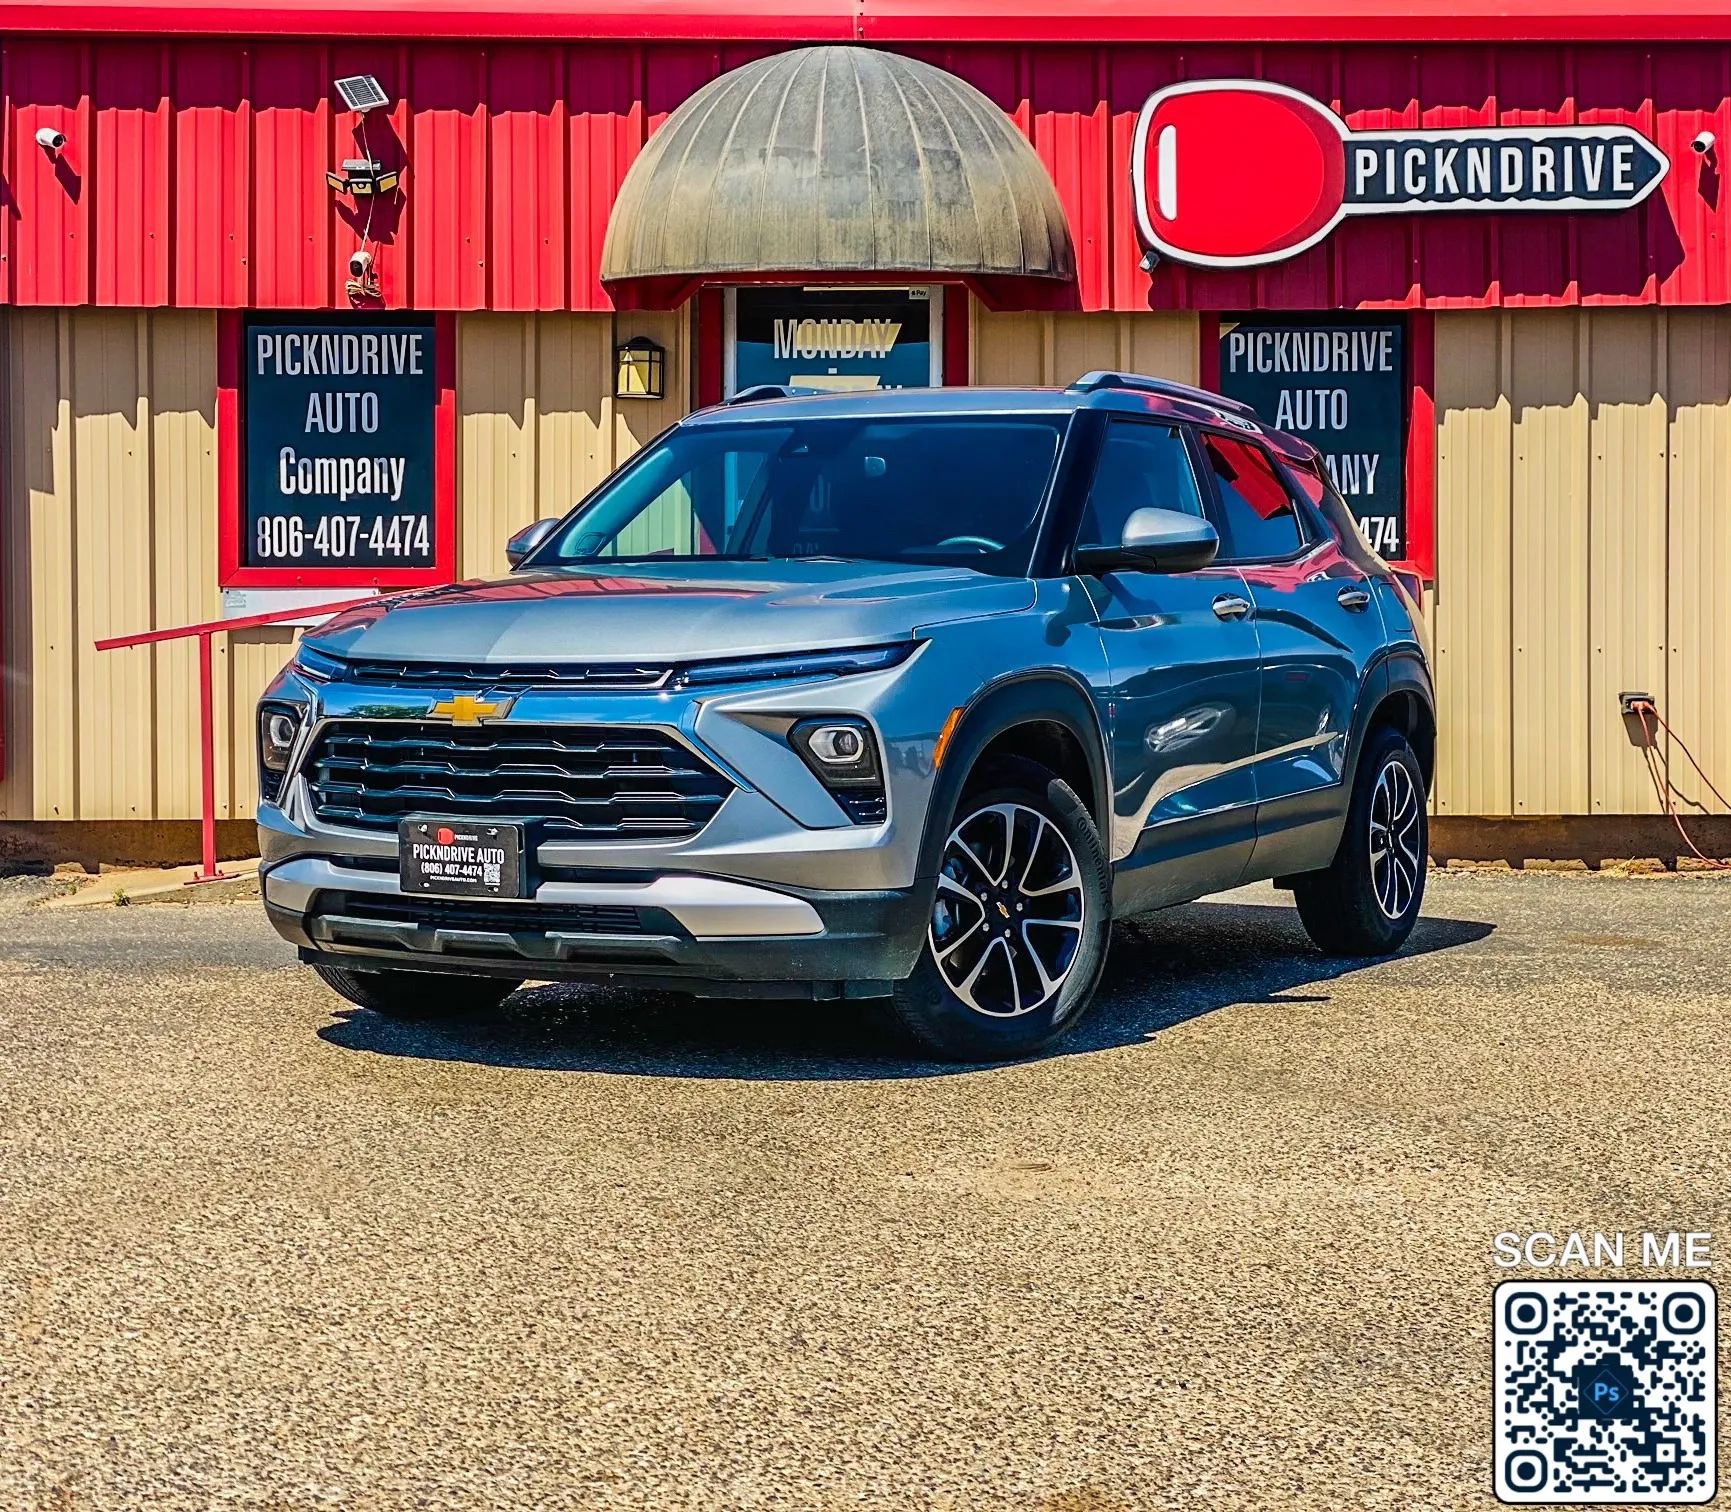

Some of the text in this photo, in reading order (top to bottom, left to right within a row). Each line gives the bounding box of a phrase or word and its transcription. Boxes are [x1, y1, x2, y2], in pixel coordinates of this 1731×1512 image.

[1355, 145, 1635, 196] PICKNDRIVE
[916, 289, 927, 297] Pay
[256, 333, 424, 376] PICKNDRIVE
[773, 318, 892, 359] MONDAY
[1229, 331, 1393, 373] PICKNDRIVE
[304, 391, 380, 434] AUTO
[1274, 389, 1349, 431] AUTO
[279, 445, 406, 501] Company
[1325, 454, 1380, 495] ANY
[256, 514, 431, 558] 806-407-4474
[1359, 516, 1400, 553] 474
[413, 843, 505, 864] PICKNDRIVE AUTO
[454, 834, 478, 842] PICKNDRIVE
[420, 861, 483, 877] (806) 407-4474
